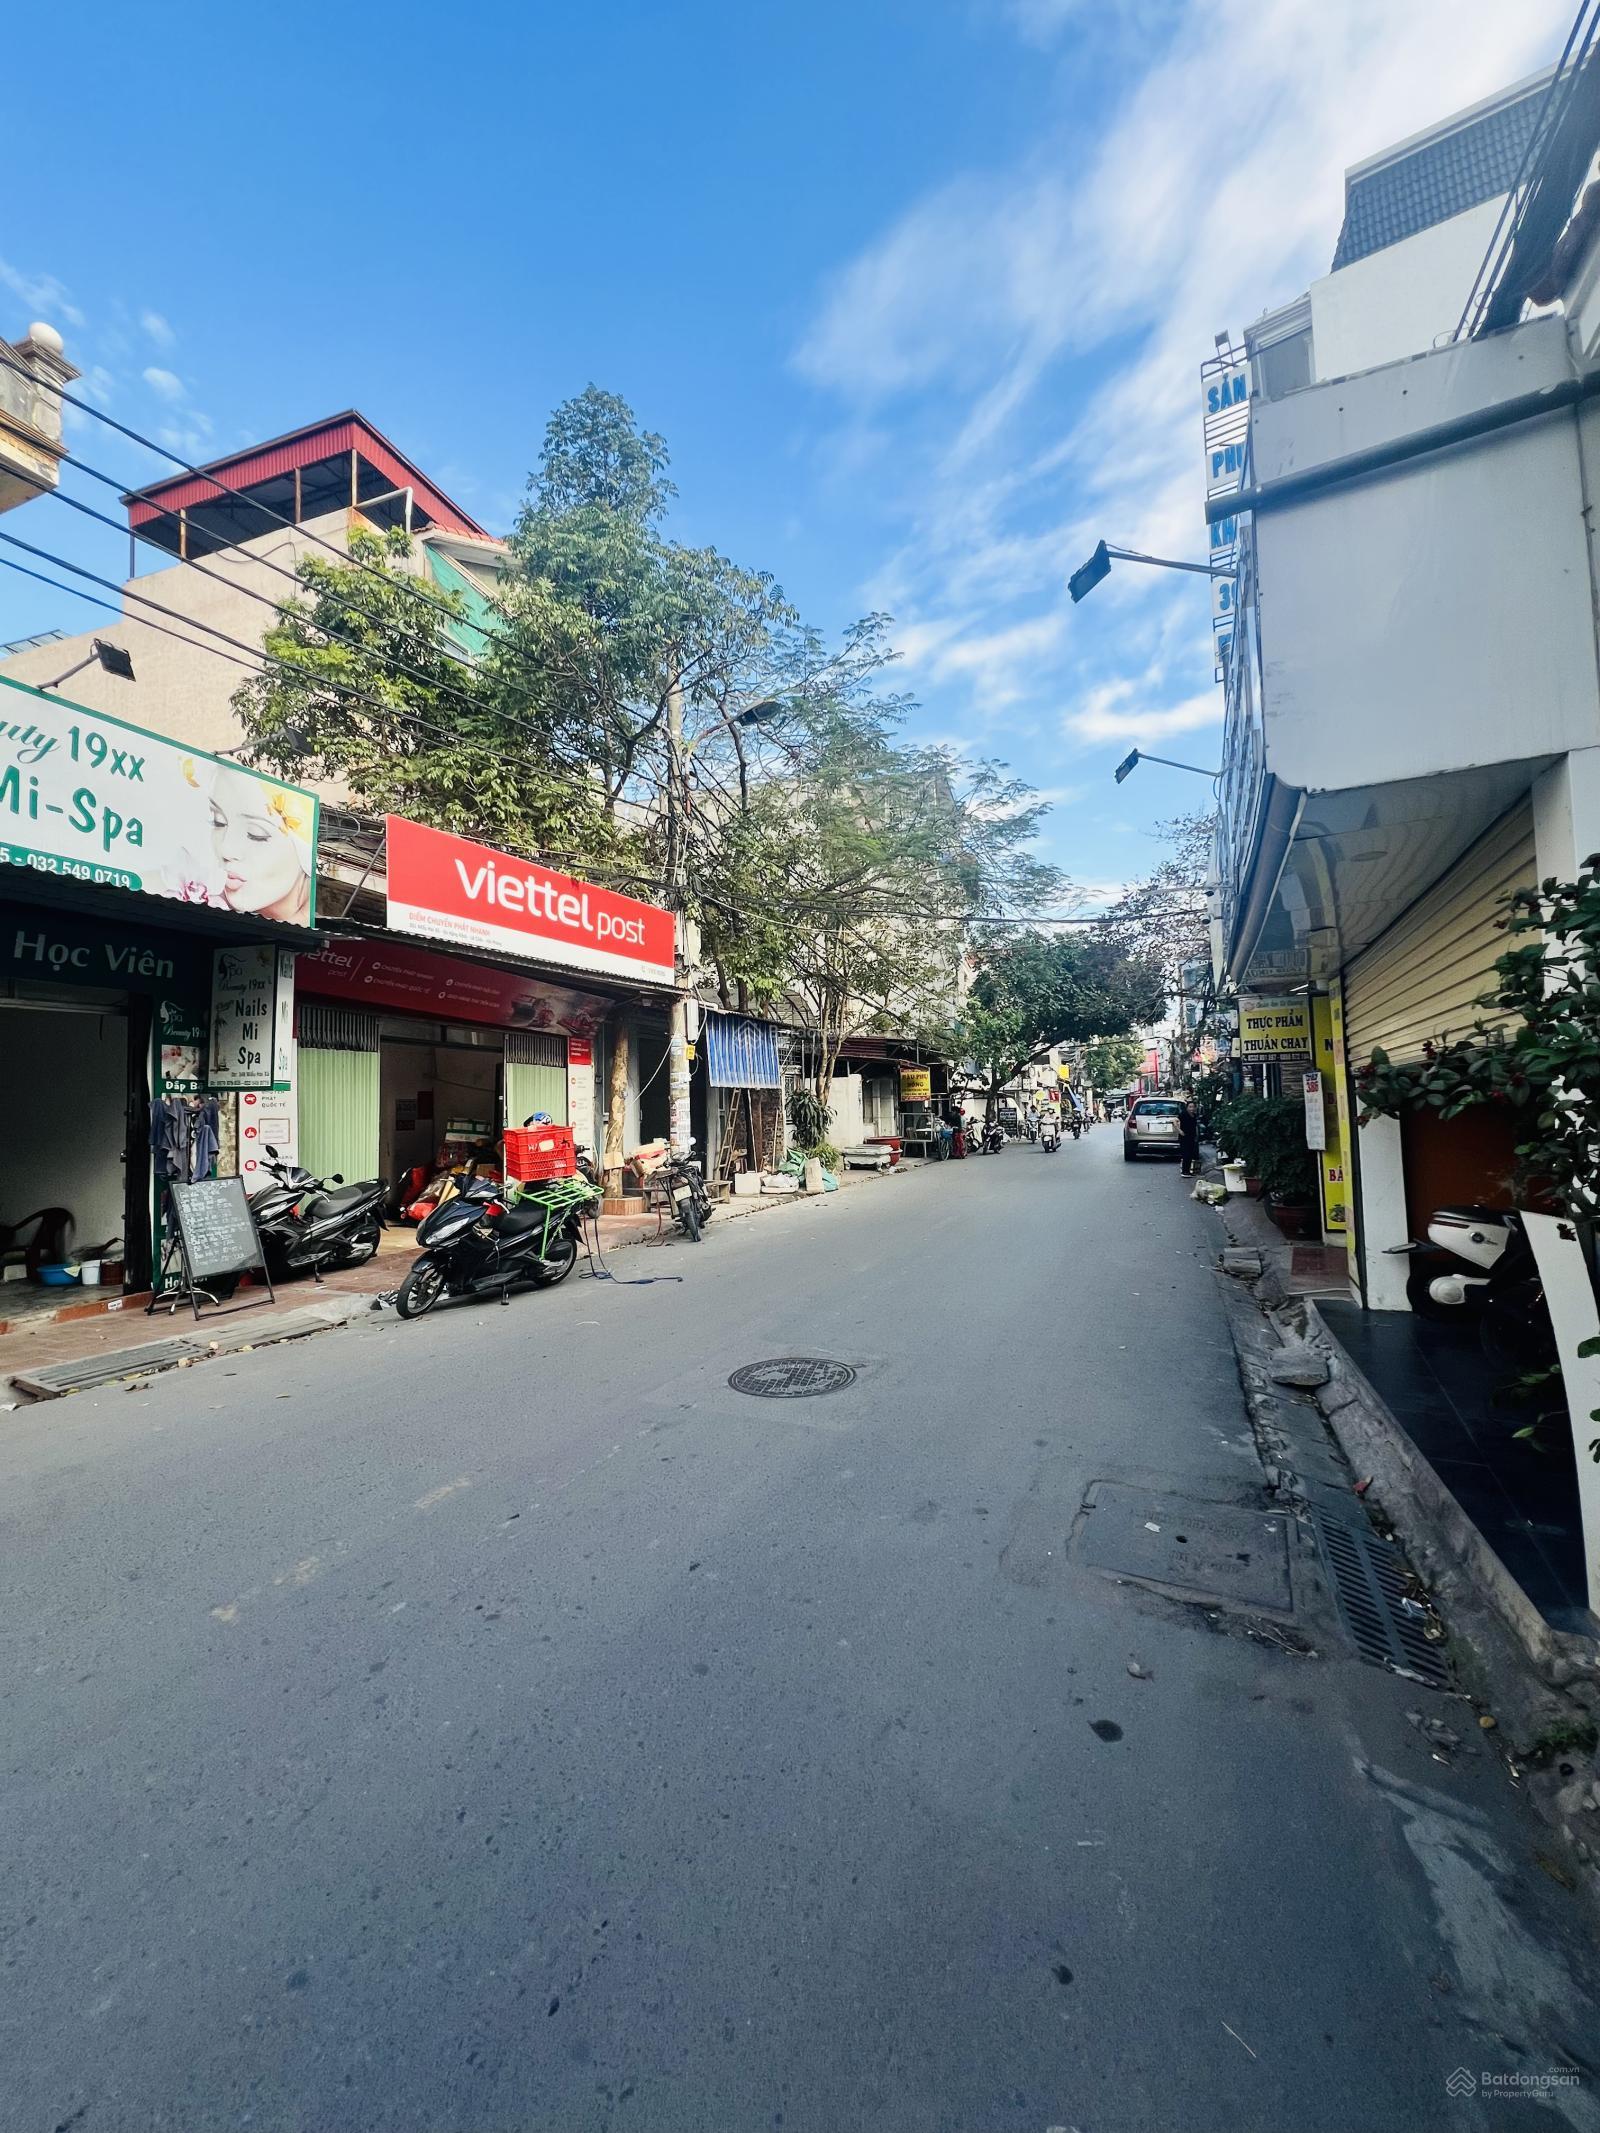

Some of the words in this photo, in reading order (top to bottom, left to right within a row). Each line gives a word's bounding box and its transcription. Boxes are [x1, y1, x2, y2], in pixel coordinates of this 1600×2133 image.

[68, 725, 146, 783] 19xx
[62, 862, 91, 880] 549
[454, 858, 594, 931] viettel
[597, 911, 646, 945] post
[14, 930, 90, 971] Học
[105, 944, 174, 978] Viên
[235, 998, 268, 1017] Nails
[242, 1022, 258, 1041] Mi
[1280, 1037, 1308, 1049] CHAY
[237, 1046, 261, 1070] Spa
